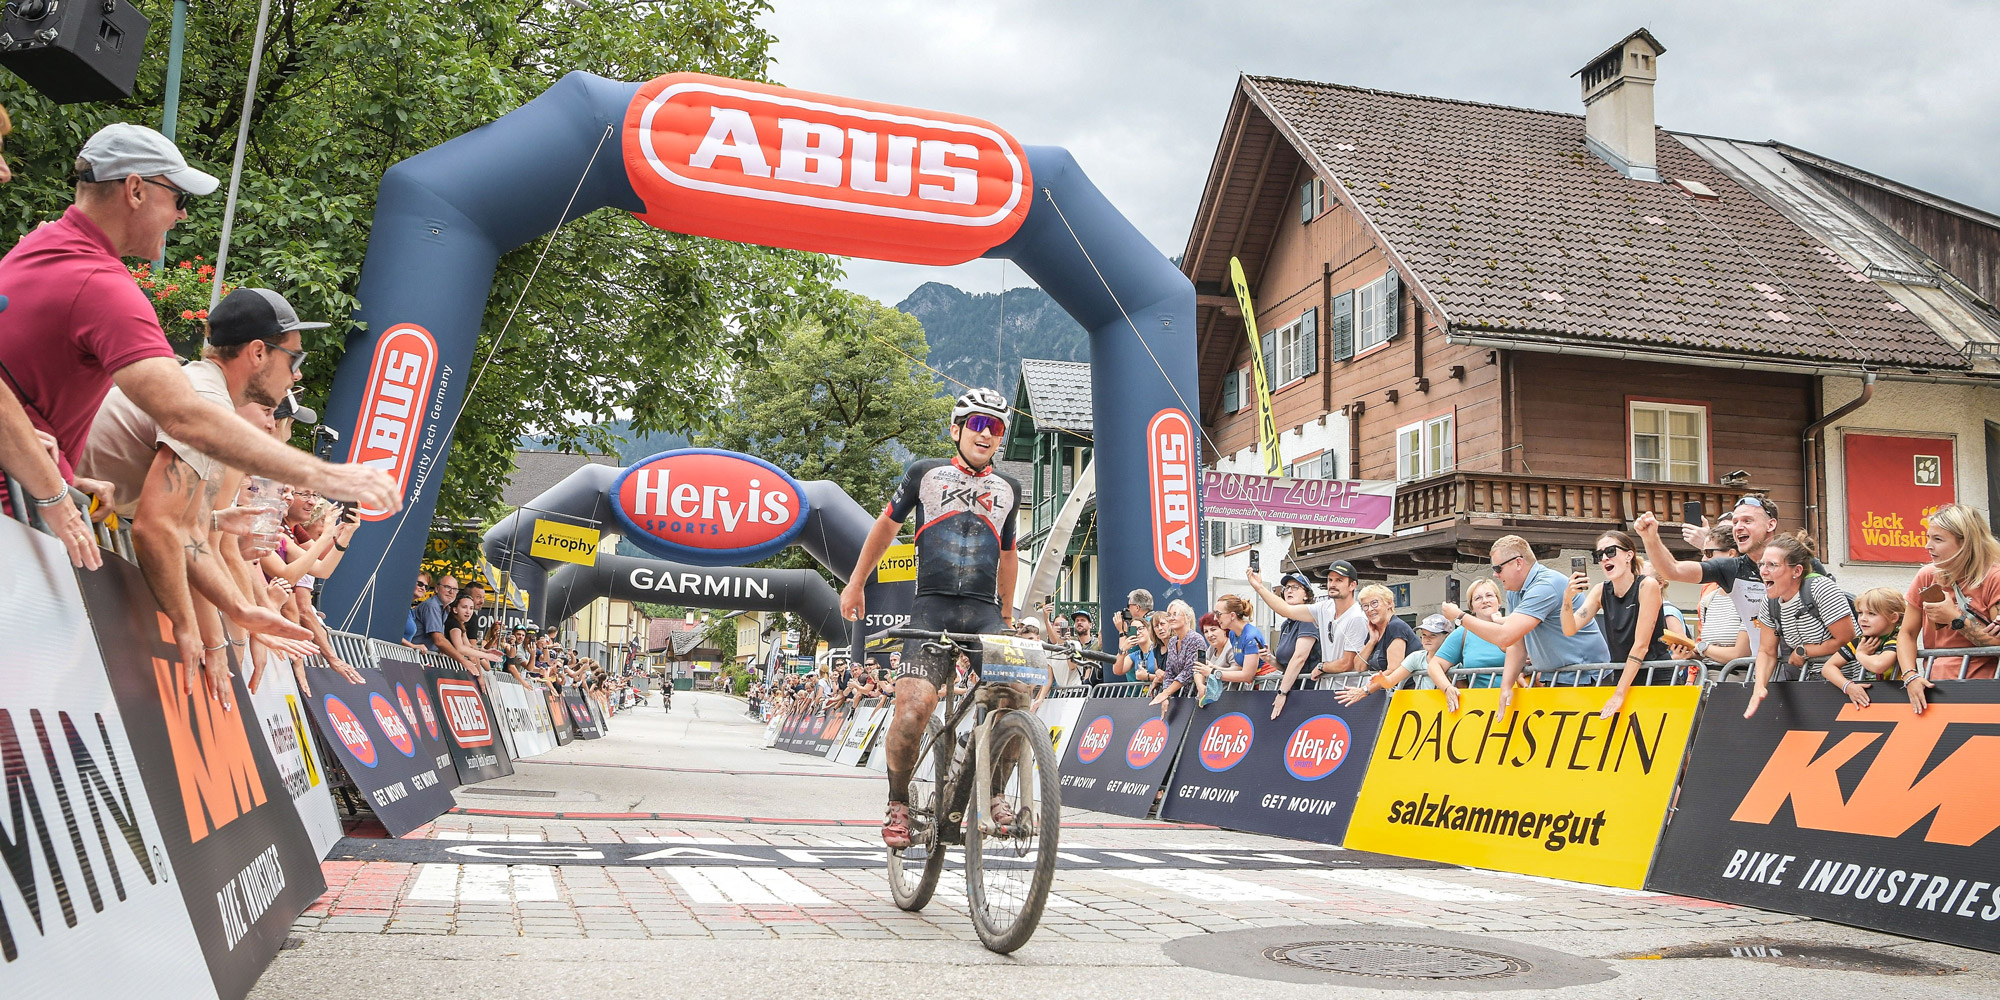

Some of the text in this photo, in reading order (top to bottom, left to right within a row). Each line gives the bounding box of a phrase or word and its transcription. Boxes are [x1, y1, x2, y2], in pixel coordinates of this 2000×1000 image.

[689, 106, 979, 206] ABUS
[410, 364, 453, 503] Security Tech Germany
[634, 469, 790, 532] Hervis
[1160, 433, 1191, 559] ABUS
[1284, 478, 1361, 509] ZOPF
[646, 519, 719, 535] SPORTS
[1268, 509, 1297, 519] Zentrum
[1313, 512, 1328, 522] Bad
[1328, 515, 1356, 524] Goisern
[1861, 512, 1904, 529] Jack
[547, 534, 596, 555] trophy
[1862, 528, 1928, 547] Wolfski
[446, 695, 487, 731] ABUS
[1080, 725, 1110, 756] Hervis
[1129, 728, 1163, 758] Hervis
[1203, 726, 1249, 759] Hervis
[1289, 730, 1345, 767] Hervis
[1388, 709, 1668, 776] DACHSTEIN
[411, 775, 424, 791] GET
[1060, 774, 1097, 789] GET MOVIN'
[1106, 779, 1150, 796] GET MOVIN'
[1179, 784, 1239, 804] GET MOVIN'
[372, 788, 387, 807] GET
[1261, 794, 1336, 816] GET MOVIN'
[1387, 793, 1606, 851] salzkammergut
[216, 843, 286, 952] BIKE INDUSTRIES
[1722, 849, 2000, 921] BIKE INDUSTRIES
